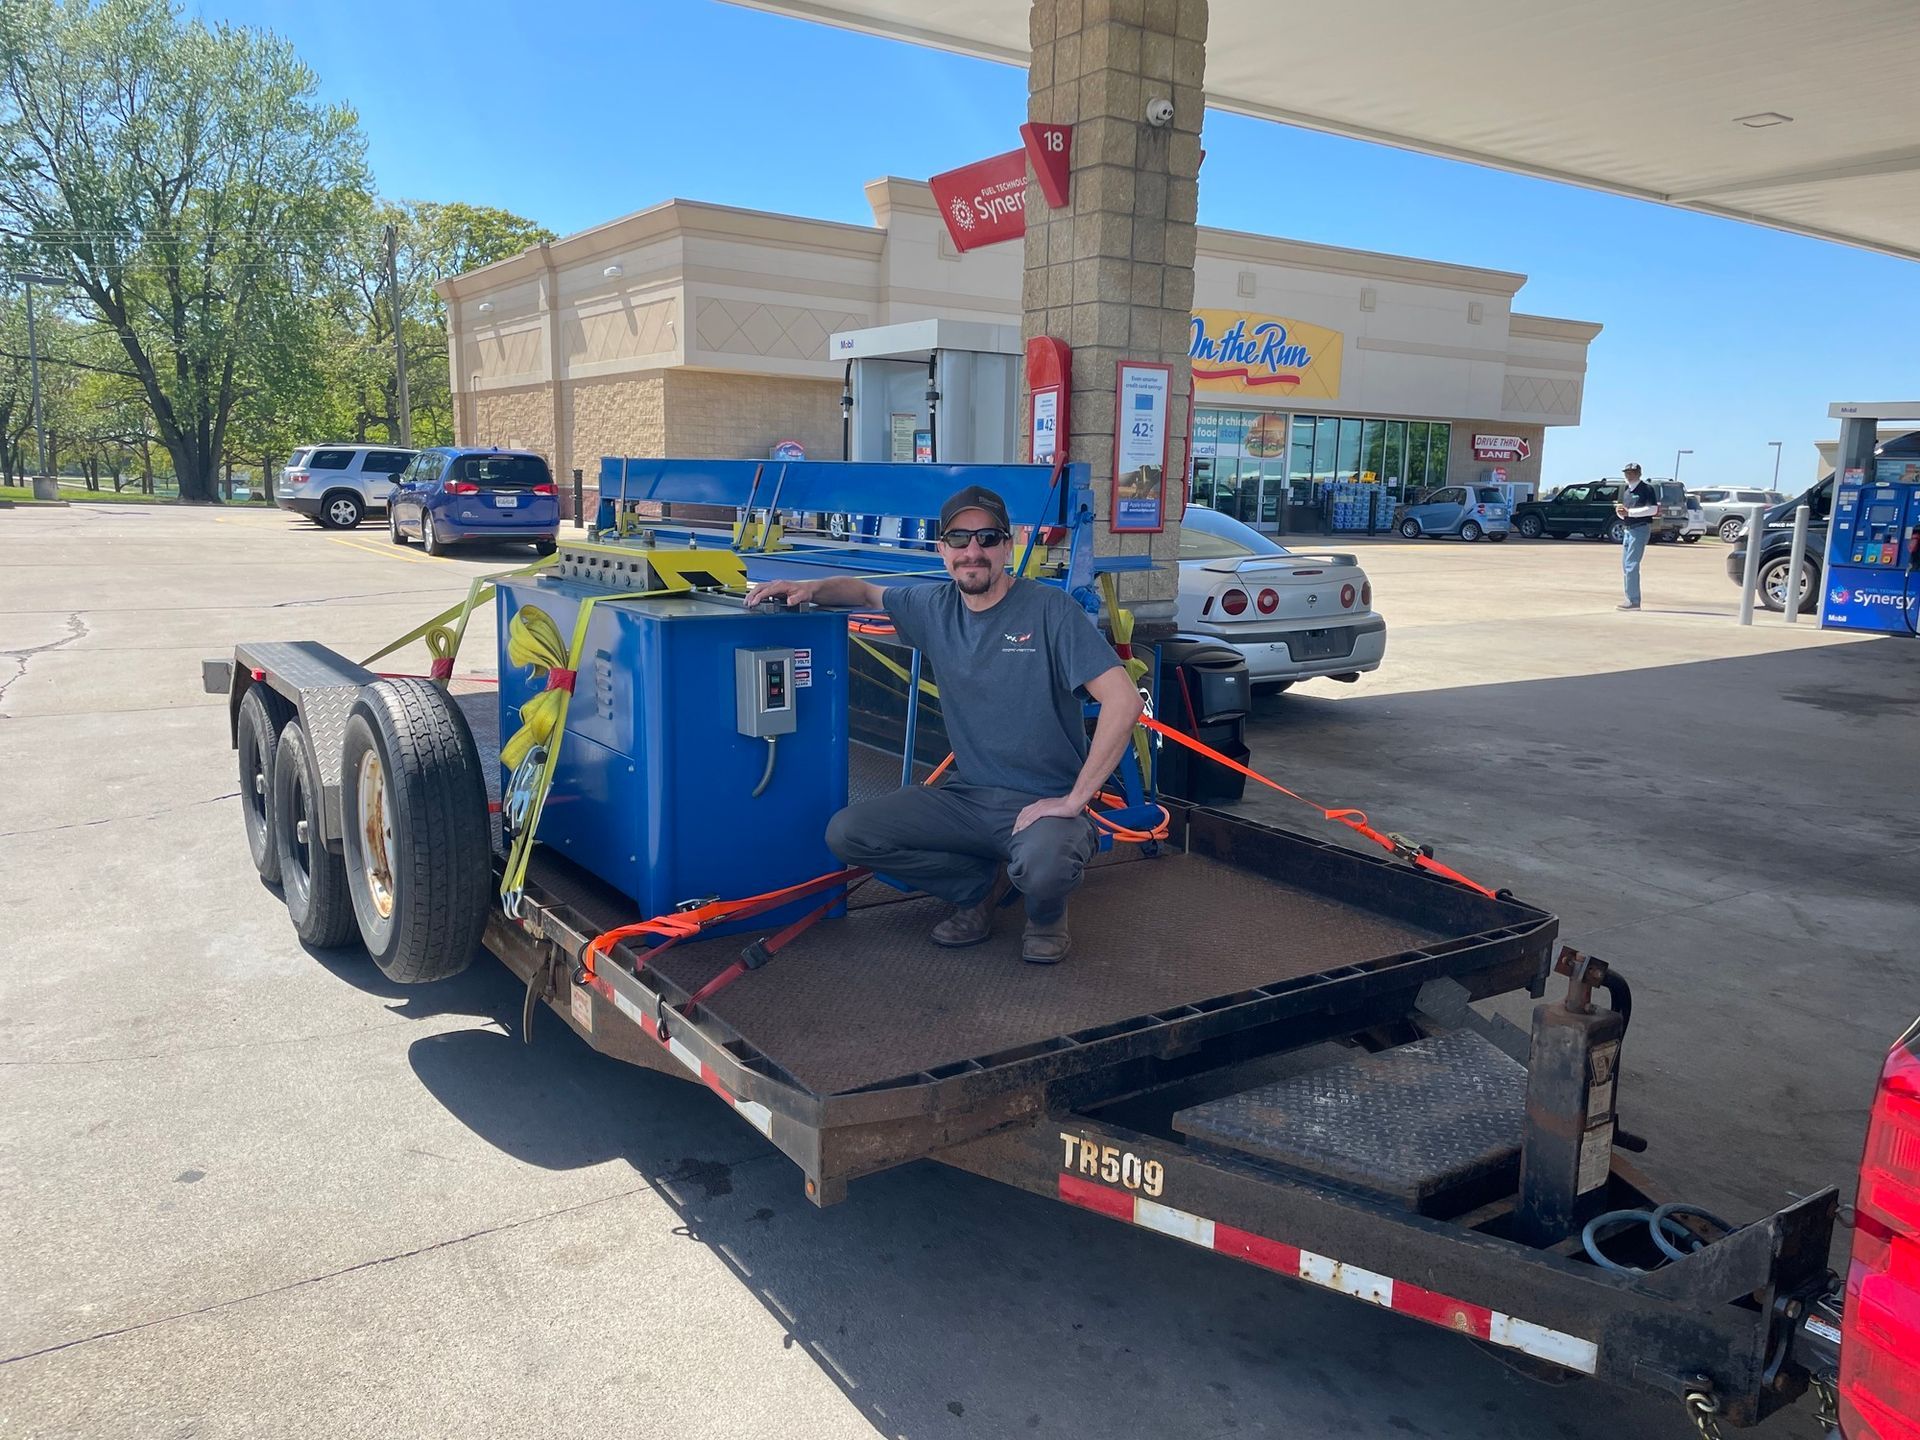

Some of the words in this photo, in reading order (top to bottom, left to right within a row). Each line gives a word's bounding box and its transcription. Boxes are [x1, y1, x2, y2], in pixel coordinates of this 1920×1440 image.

[1043, 131, 1064, 152] 18
[981, 187, 995, 196] FUEL
[840, 339, 854, 349] Mobil
[1219, 320, 1260, 364] the
[1254, 323, 1311, 373] Run
[1197, 427, 1217, 437] food
[1476, 437, 1498, 447] DRIVE
[1499, 438, 1519, 448] THRU
[1480, 451, 1511, 459] LANE
[917, 527, 926, 540] 18
[1854, 590, 1915, 610] Synergy
[1828, 614, 1847, 622] Mobil
[1060, 1132, 1164, 1197] TR509
